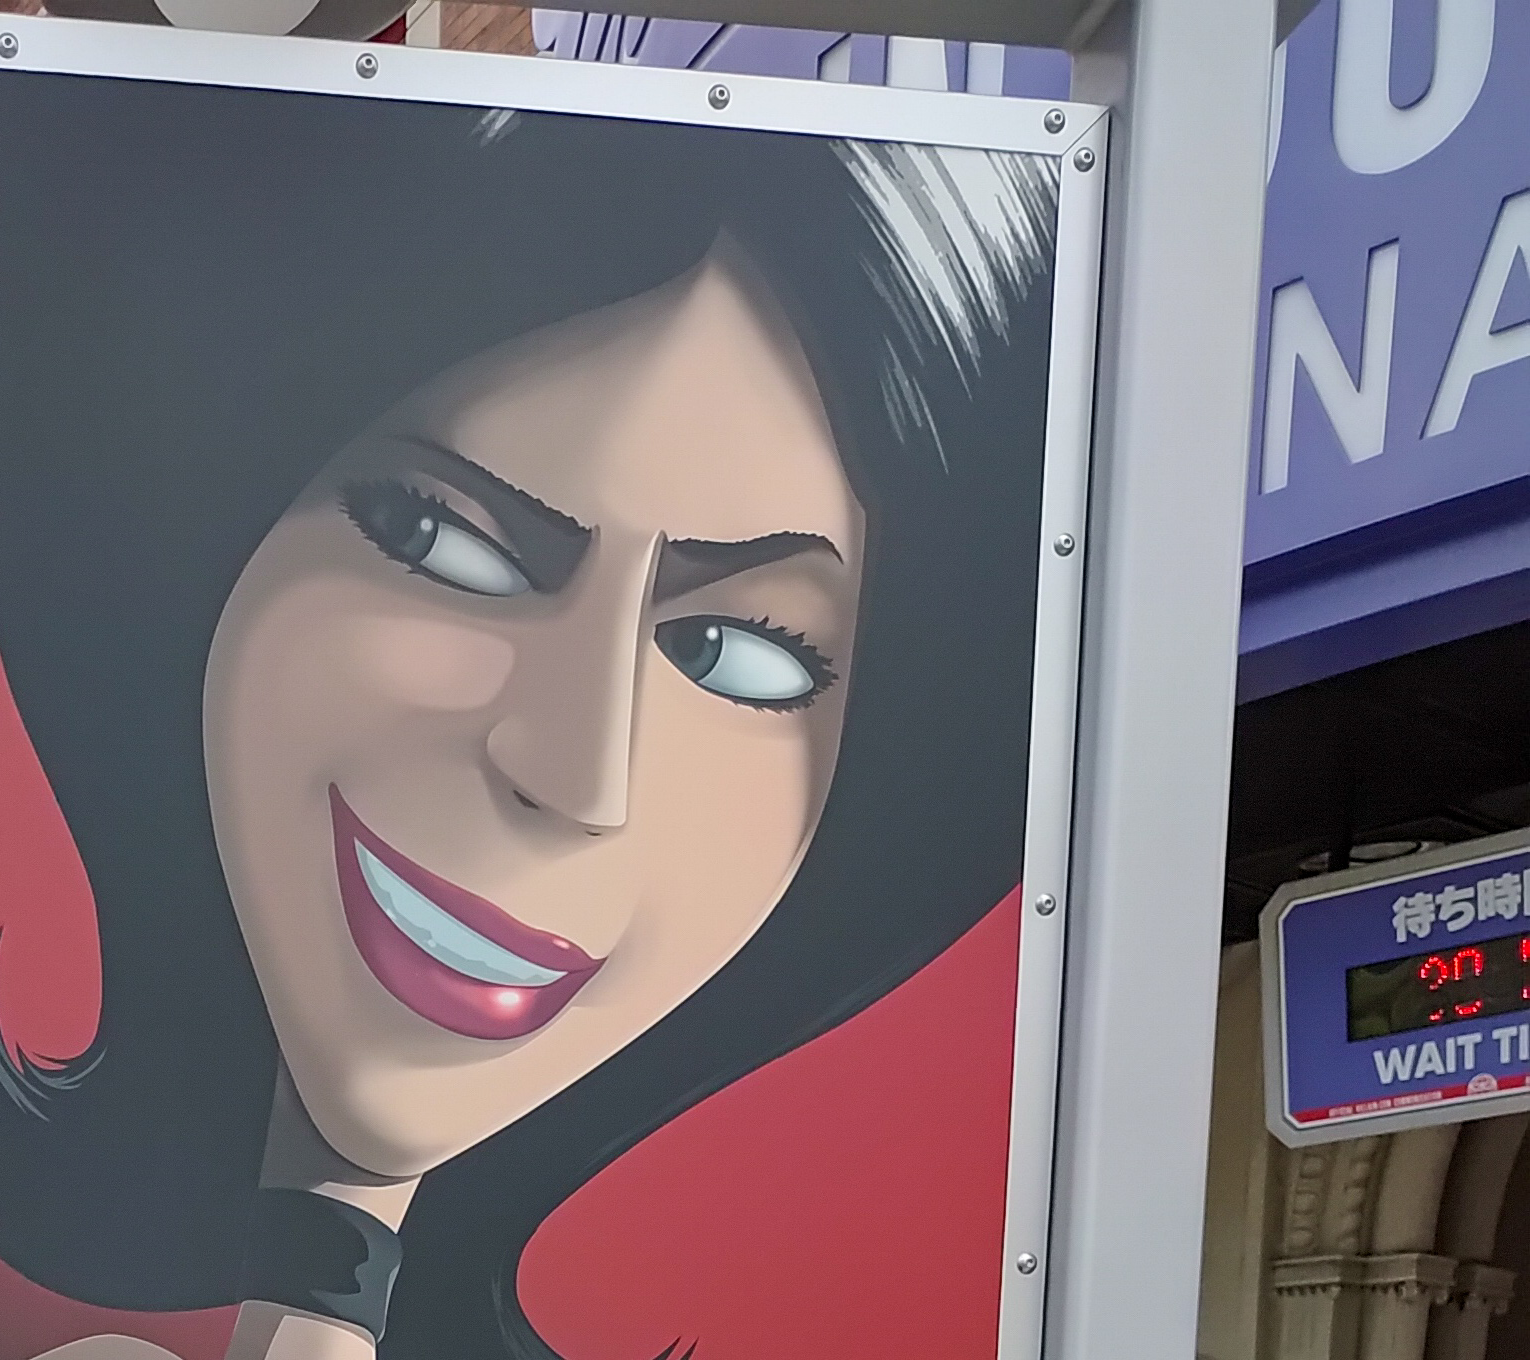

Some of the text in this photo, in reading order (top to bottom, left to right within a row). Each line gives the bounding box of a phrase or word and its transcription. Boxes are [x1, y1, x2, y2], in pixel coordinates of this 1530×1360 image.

[1392, 868, 1530, 943] 待ち時
[1373, 1032, 1482, 1085] WAIT
